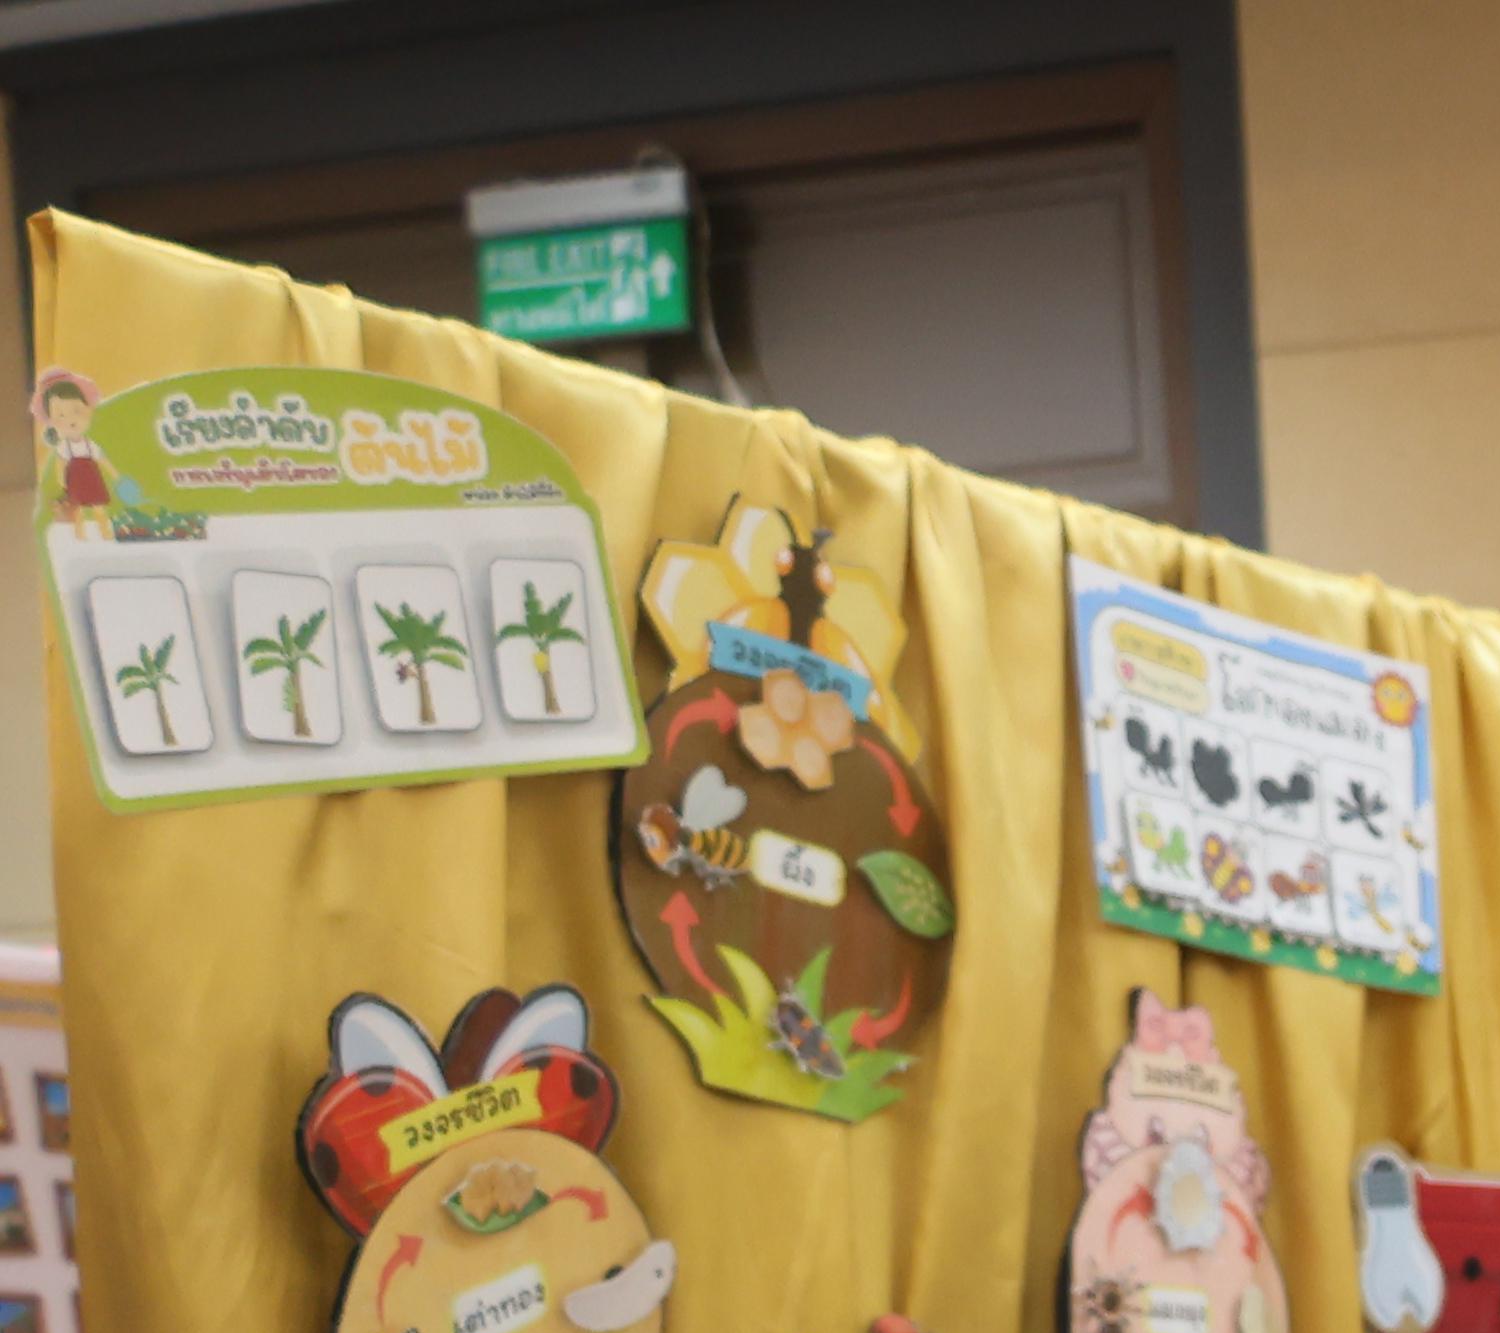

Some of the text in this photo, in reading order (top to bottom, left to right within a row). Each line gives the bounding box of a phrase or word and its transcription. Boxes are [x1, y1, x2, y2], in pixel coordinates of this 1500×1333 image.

[162, 395, 482, 479] เรียงลำดับ ต้นไม้
[403, 1085, 521, 1149] วงจรชีวิต
